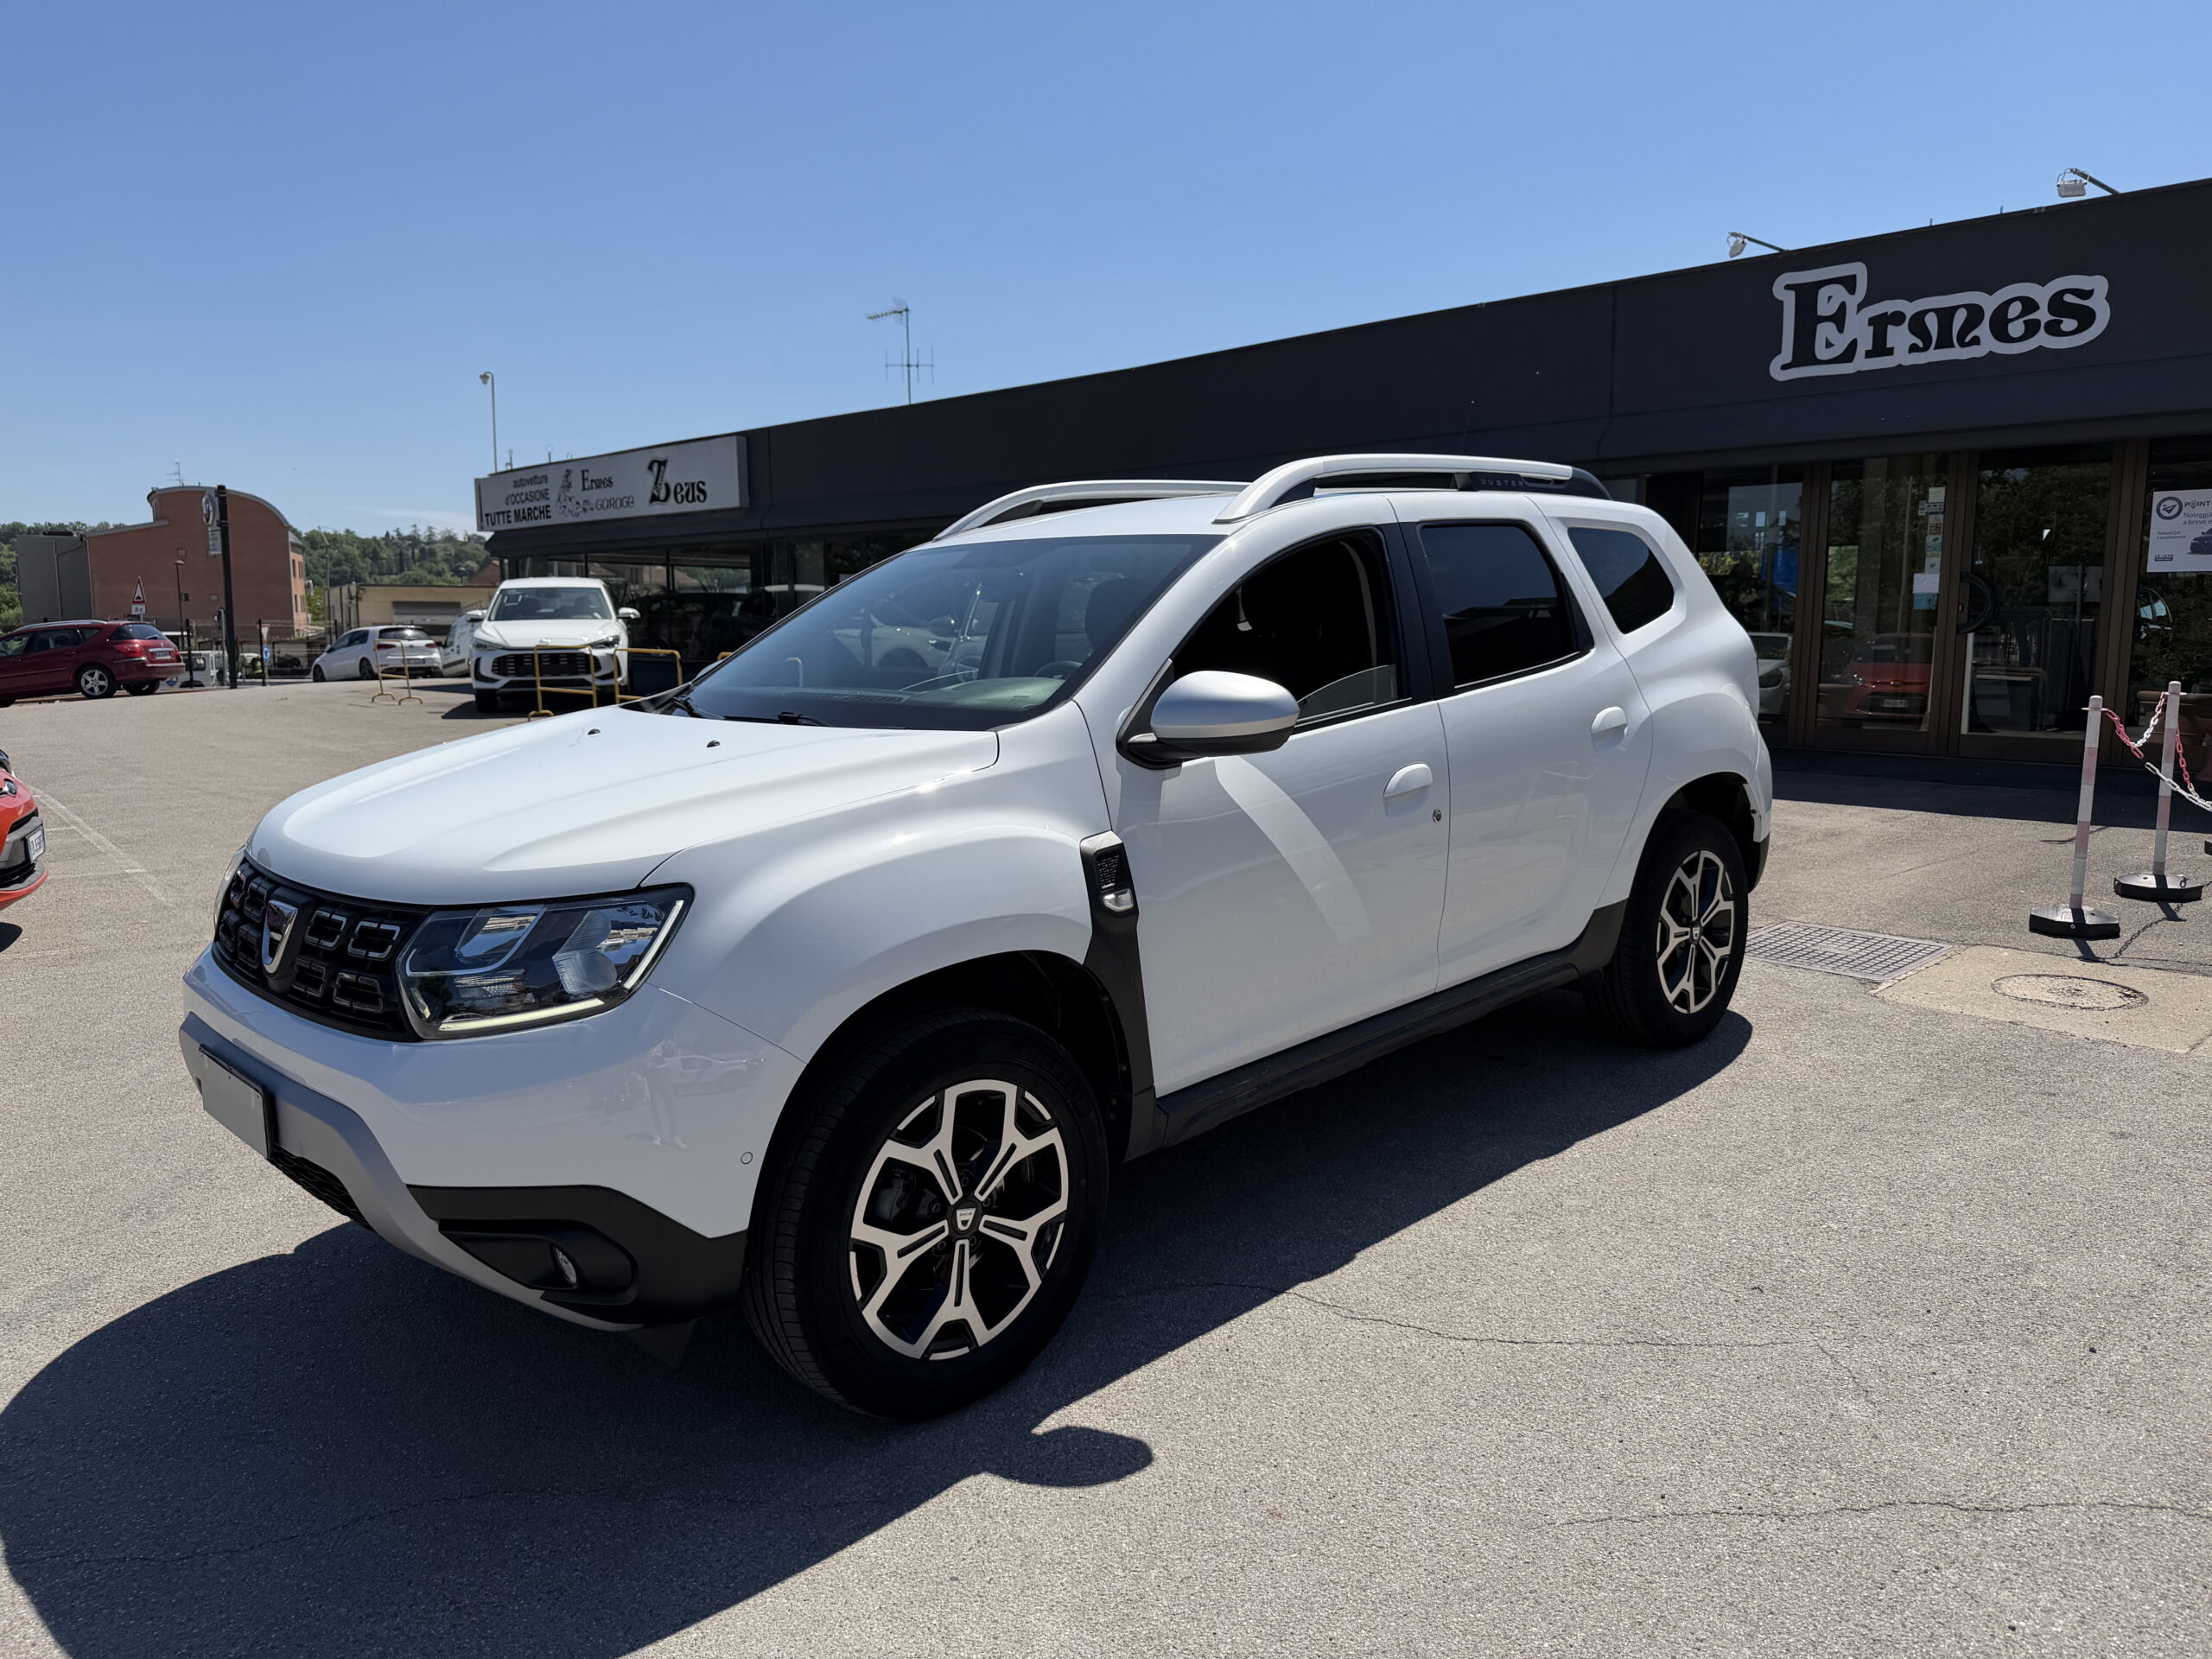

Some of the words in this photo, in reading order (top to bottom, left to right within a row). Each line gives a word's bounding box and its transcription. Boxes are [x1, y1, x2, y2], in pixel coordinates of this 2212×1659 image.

[1778, 272, 2096, 372] Ermes
[581, 469, 613, 492] Ermes
[647, 459, 708, 505] Zeus
[1480, 478, 1524, 486] DUSTER
[505, 488, 550, 506] d'OCCASIONE
[484, 510, 512, 526] TUTTE
[513, 505, 552, 523] MARCHE
